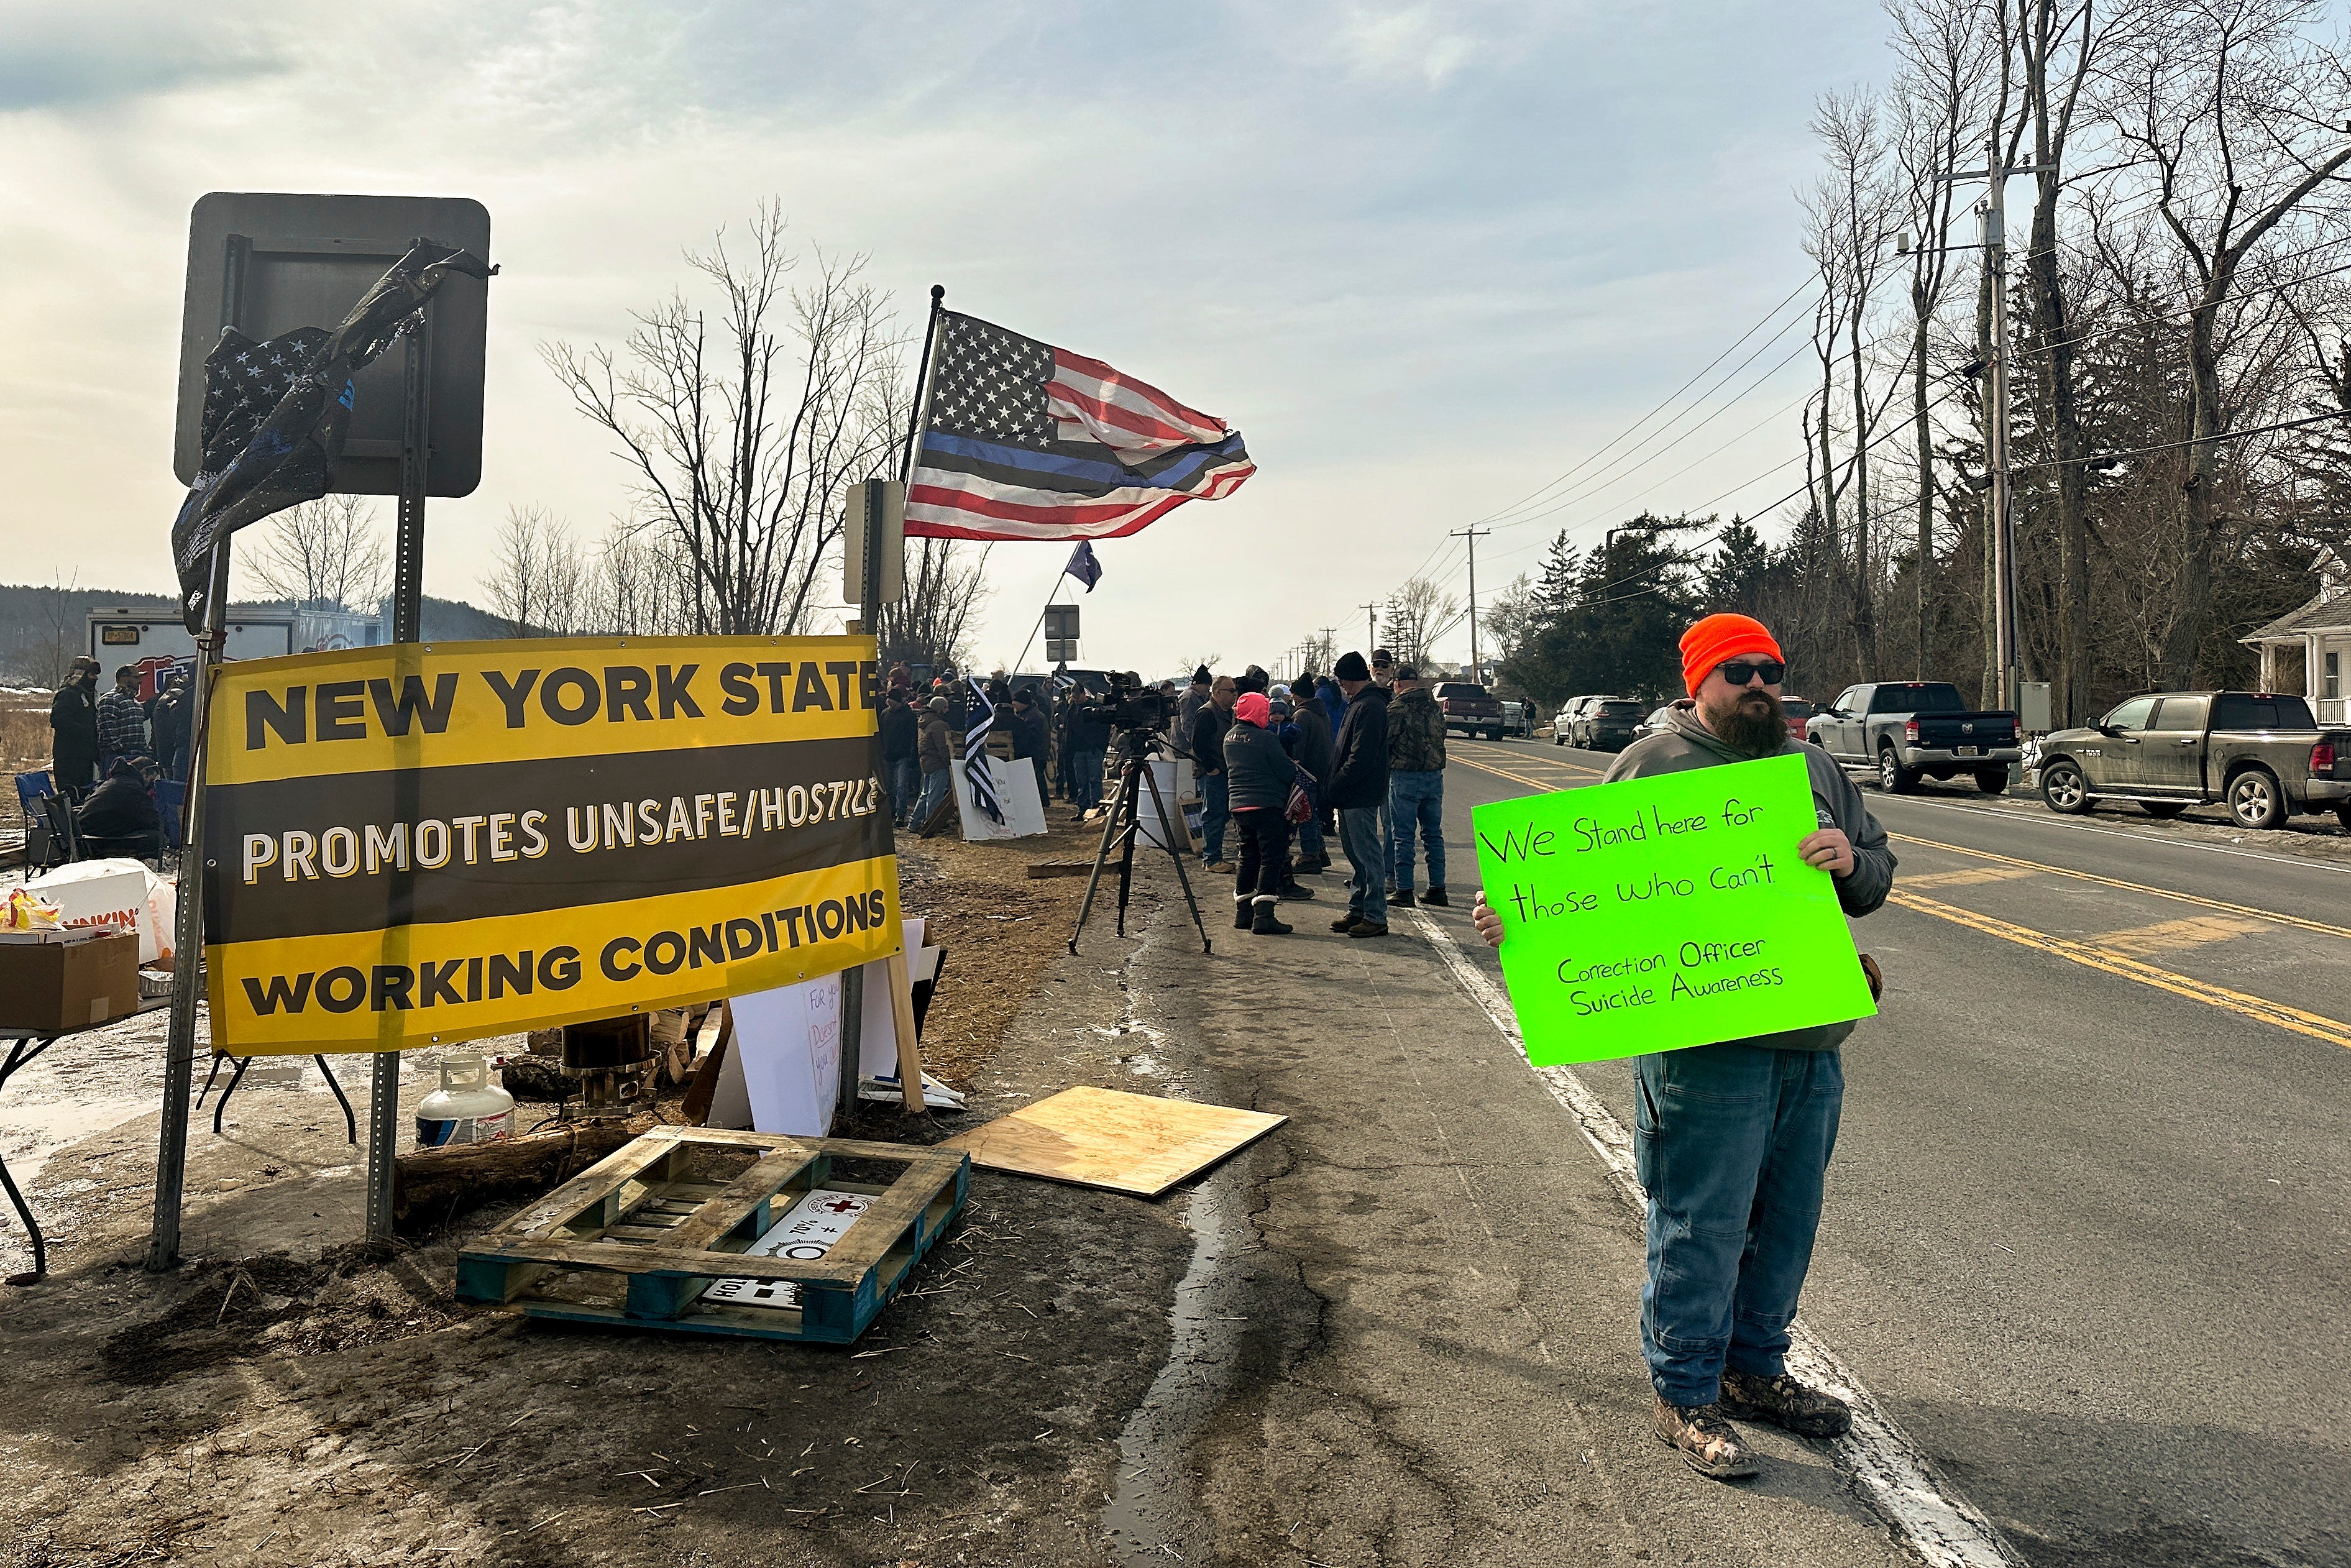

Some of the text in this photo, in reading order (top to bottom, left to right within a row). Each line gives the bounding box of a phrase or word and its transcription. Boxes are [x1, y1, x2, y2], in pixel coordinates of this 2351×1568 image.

[245, 673, 459, 751] NEW
[480, 664, 705, 728] YORK
[720, 661, 876, 716] STATE
[243, 777, 878, 885] PROMOTES UNSAFE/HOSTILE
[1479, 799, 1764, 864] We Stand here for
[1509, 883, 1598, 923] those
[241, 889, 885, 1016] WORKING CONDITIONS
[1557, 939, 1766, 984] Correction Officer
[1570, 968, 1784, 1016] Suicide Awareness
[789, 1220, 818, 1235] 70%
